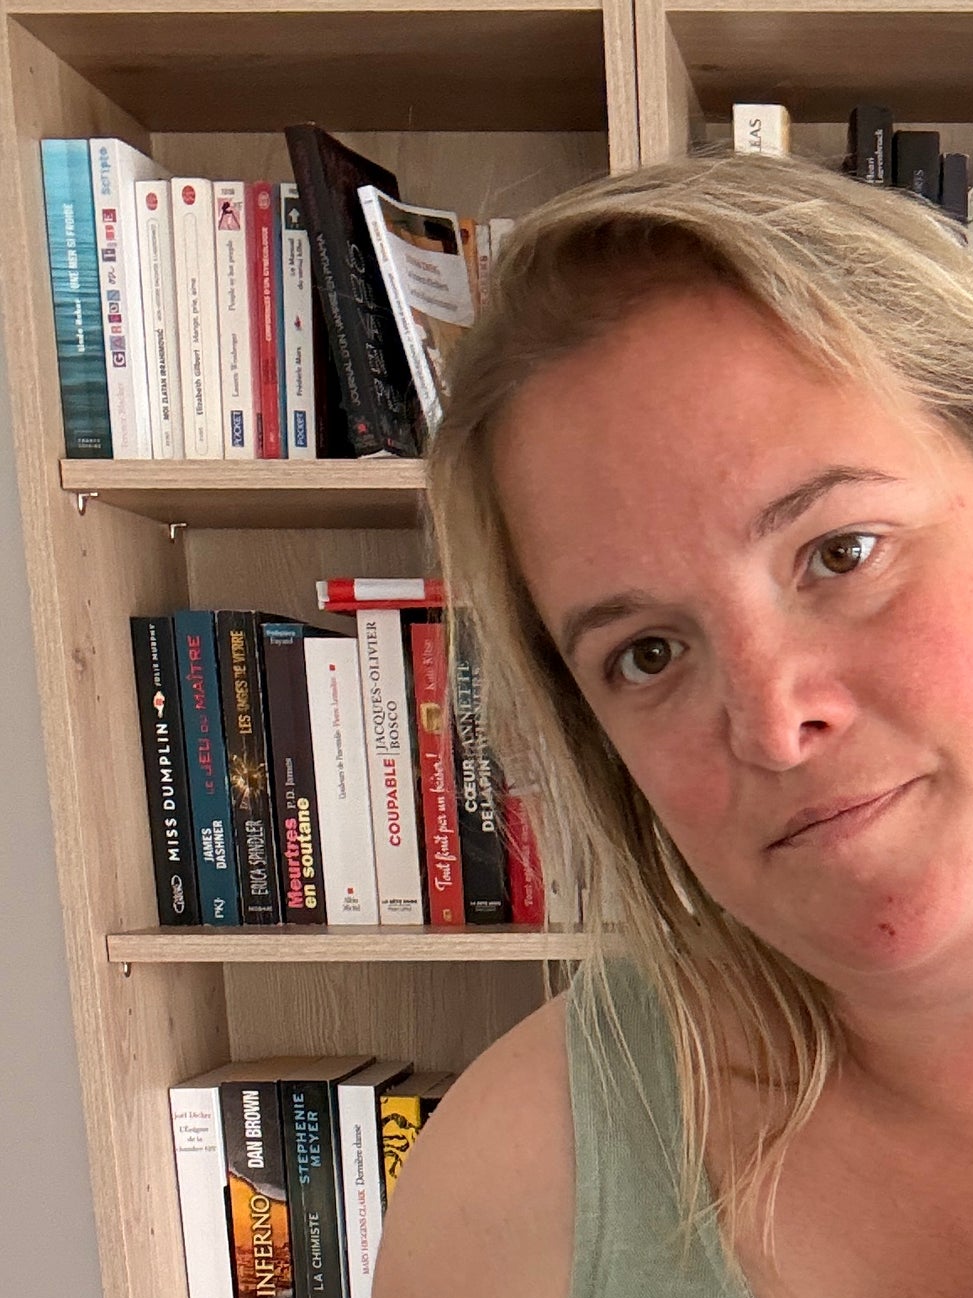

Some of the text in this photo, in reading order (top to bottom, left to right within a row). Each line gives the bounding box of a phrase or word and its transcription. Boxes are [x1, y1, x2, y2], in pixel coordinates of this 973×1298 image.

[66, 238, 77, 249] SI
[67, 249, 78, 269] MER
[192, 349, 202, 377] Gilbert
[345, 360, 361, 407] JOURNAL
[160, 378, 169, 404] ZLATAN
[193, 378, 204, 416] Elizabeth
[294, 411, 306, 446] POCKET
[186, 634, 207, 711] MAÎTRE
[365, 621, 389, 751] JACQUES-OLIVIER
[237, 714, 253, 735] LES
[386, 700, 401, 750] BOSCO
[155, 723, 176, 811] DUMPLIN
[198, 738, 212, 777] JEU
[285, 757, 297, 810] P.D. James
[383, 758, 402, 847] COUPABLE
[461, 759, 478, 814] CŒUR
[164, 817, 181, 862] MISS
[201, 827, 215, 863] JAMES
[212, 819, 227, 870] DASHNER
[245, 819, 267, 867] SPINDLER
[481, 810, 495, 833] DE
[284, 817, 304, 909] Meurtres
[296, 796, 317, 910] en soutane
[434, 861, 453, 892] Tout
[249, 868, 269, 896] ERICA
[241, 1089, 265, 1170] DAN BROWN
[294, 1092, 311, 1185] STEPHENIE
[307, 1110, 322, 1169] MEYER
[352, 1123, 364, 1150] danse
[353, 1151, 367, 1187] Dernière
[250, 1193, 277, 1298] INFERNO
[308, 1211, 325, 1292] LA CHIMISTE
[361, 1253, 371, 1276] MARY
